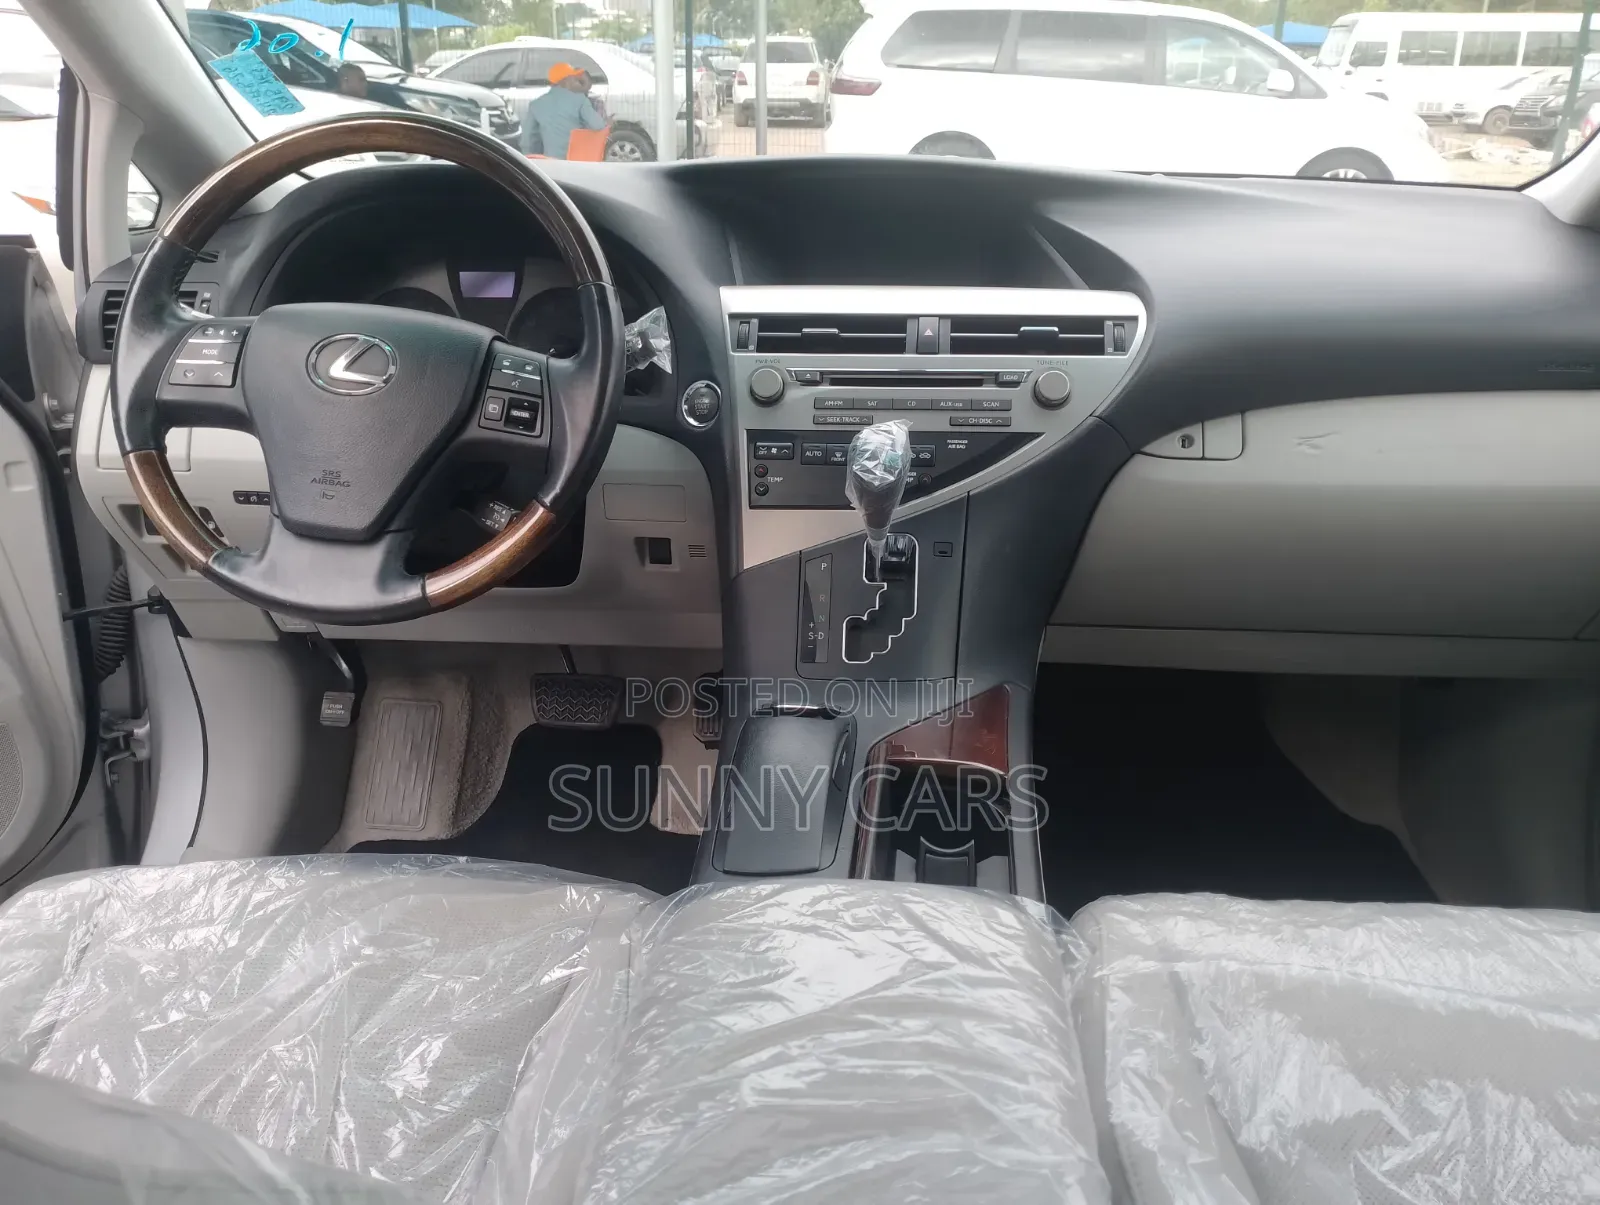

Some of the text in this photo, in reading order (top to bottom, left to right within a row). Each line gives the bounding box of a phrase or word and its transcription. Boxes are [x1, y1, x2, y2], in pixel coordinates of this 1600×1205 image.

[202, 348, 218, 356] MODE
[982, 400, 1000, 408] SCAN
[321, 469, 342, 478] SRS
[310, 477, 352, 488] AIRBAG
[821, 562, 828, 571] P
[819, 594, 825, 602] R
[818, 614, 825, 623] N
